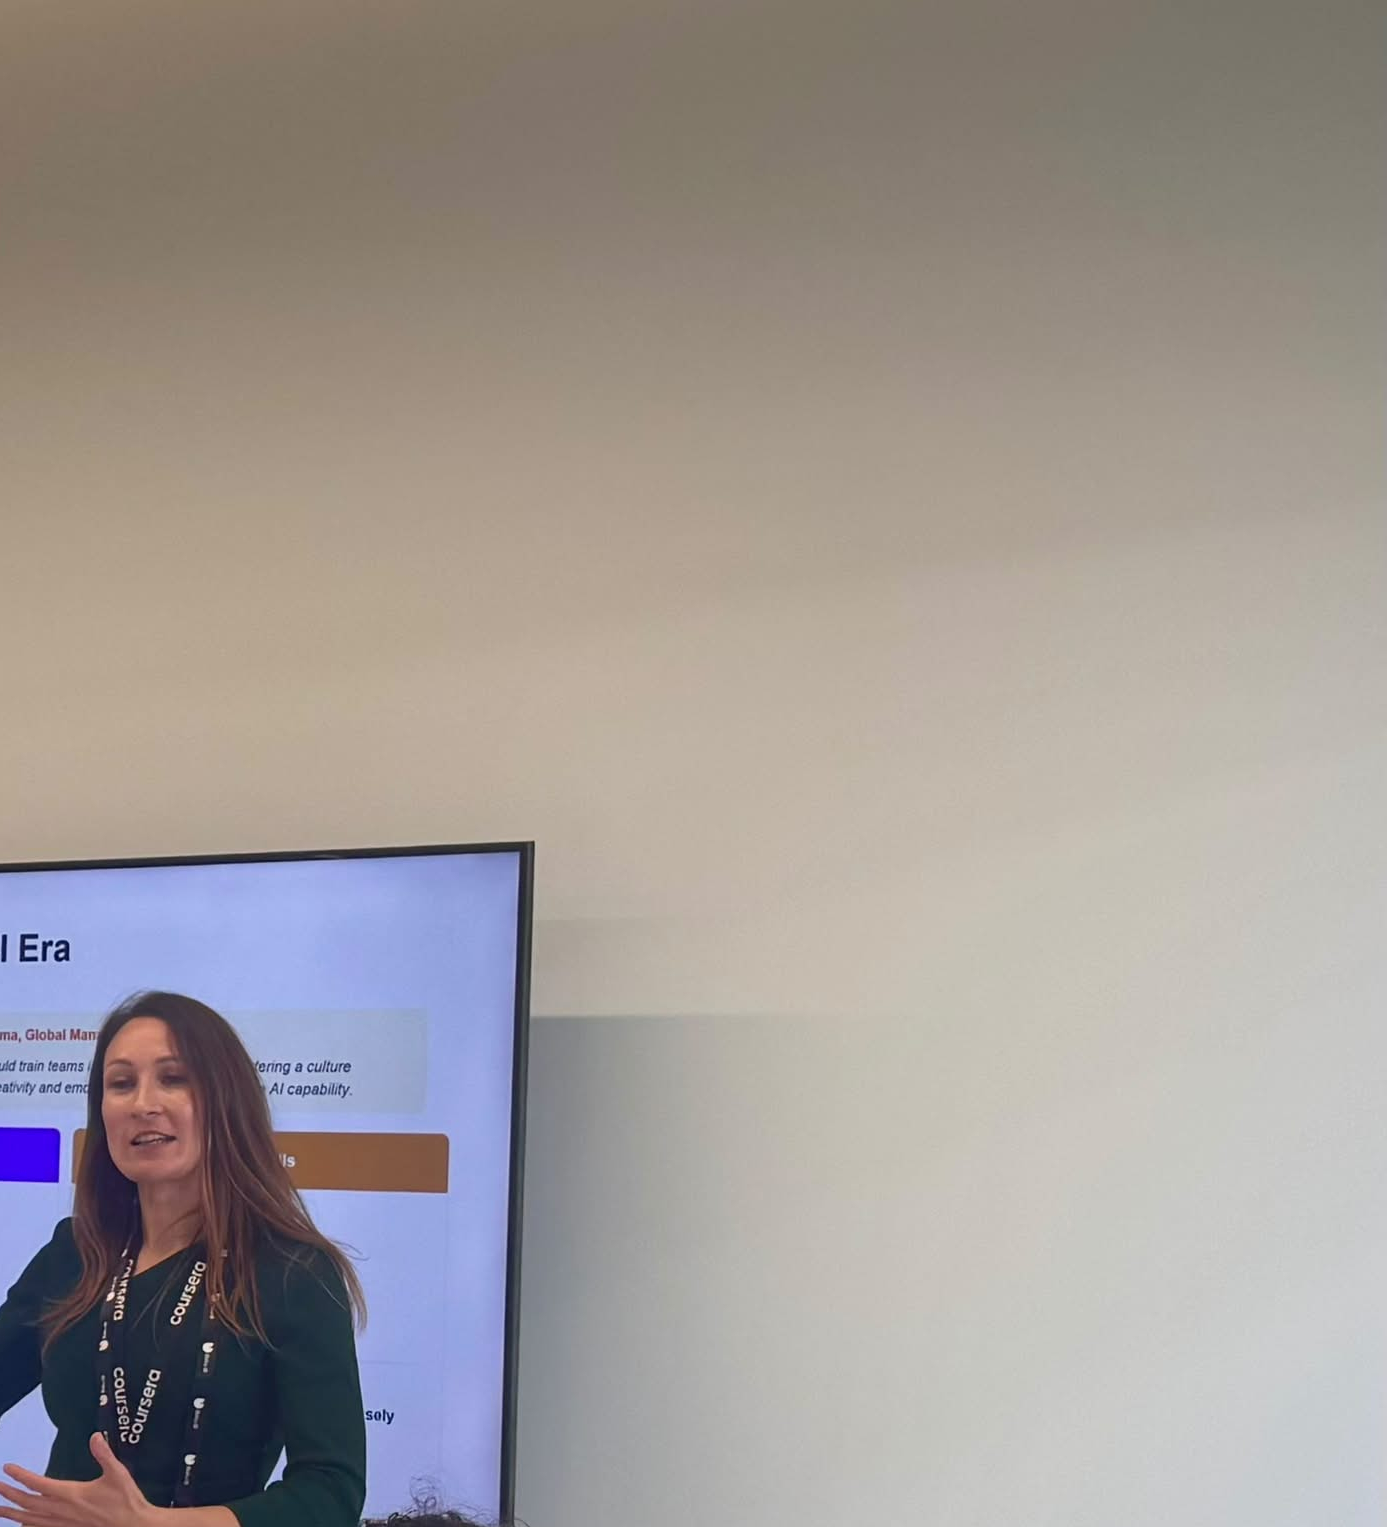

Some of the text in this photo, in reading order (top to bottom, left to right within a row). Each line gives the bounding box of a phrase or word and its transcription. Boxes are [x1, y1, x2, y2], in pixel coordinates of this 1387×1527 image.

[19, 933, 70, 962] Era
[25, 1028, 66, 1041] Global
[69, 1028, 99, 1041] Man
[19, 1060, 44, 1072] train
[48, 1060, 84, 1072] teams
[295, 1062, 303, 1072] a
[307, 1060, 351, 1073] culture
[39, 1081, 62, 1093] and
[269, 1082, 284, 1095] AI
[287, 1083, 352, 1098] capability.
[170, 1261, 207, 1326] coursera
[129, 1369, 161, 1444] coursera
